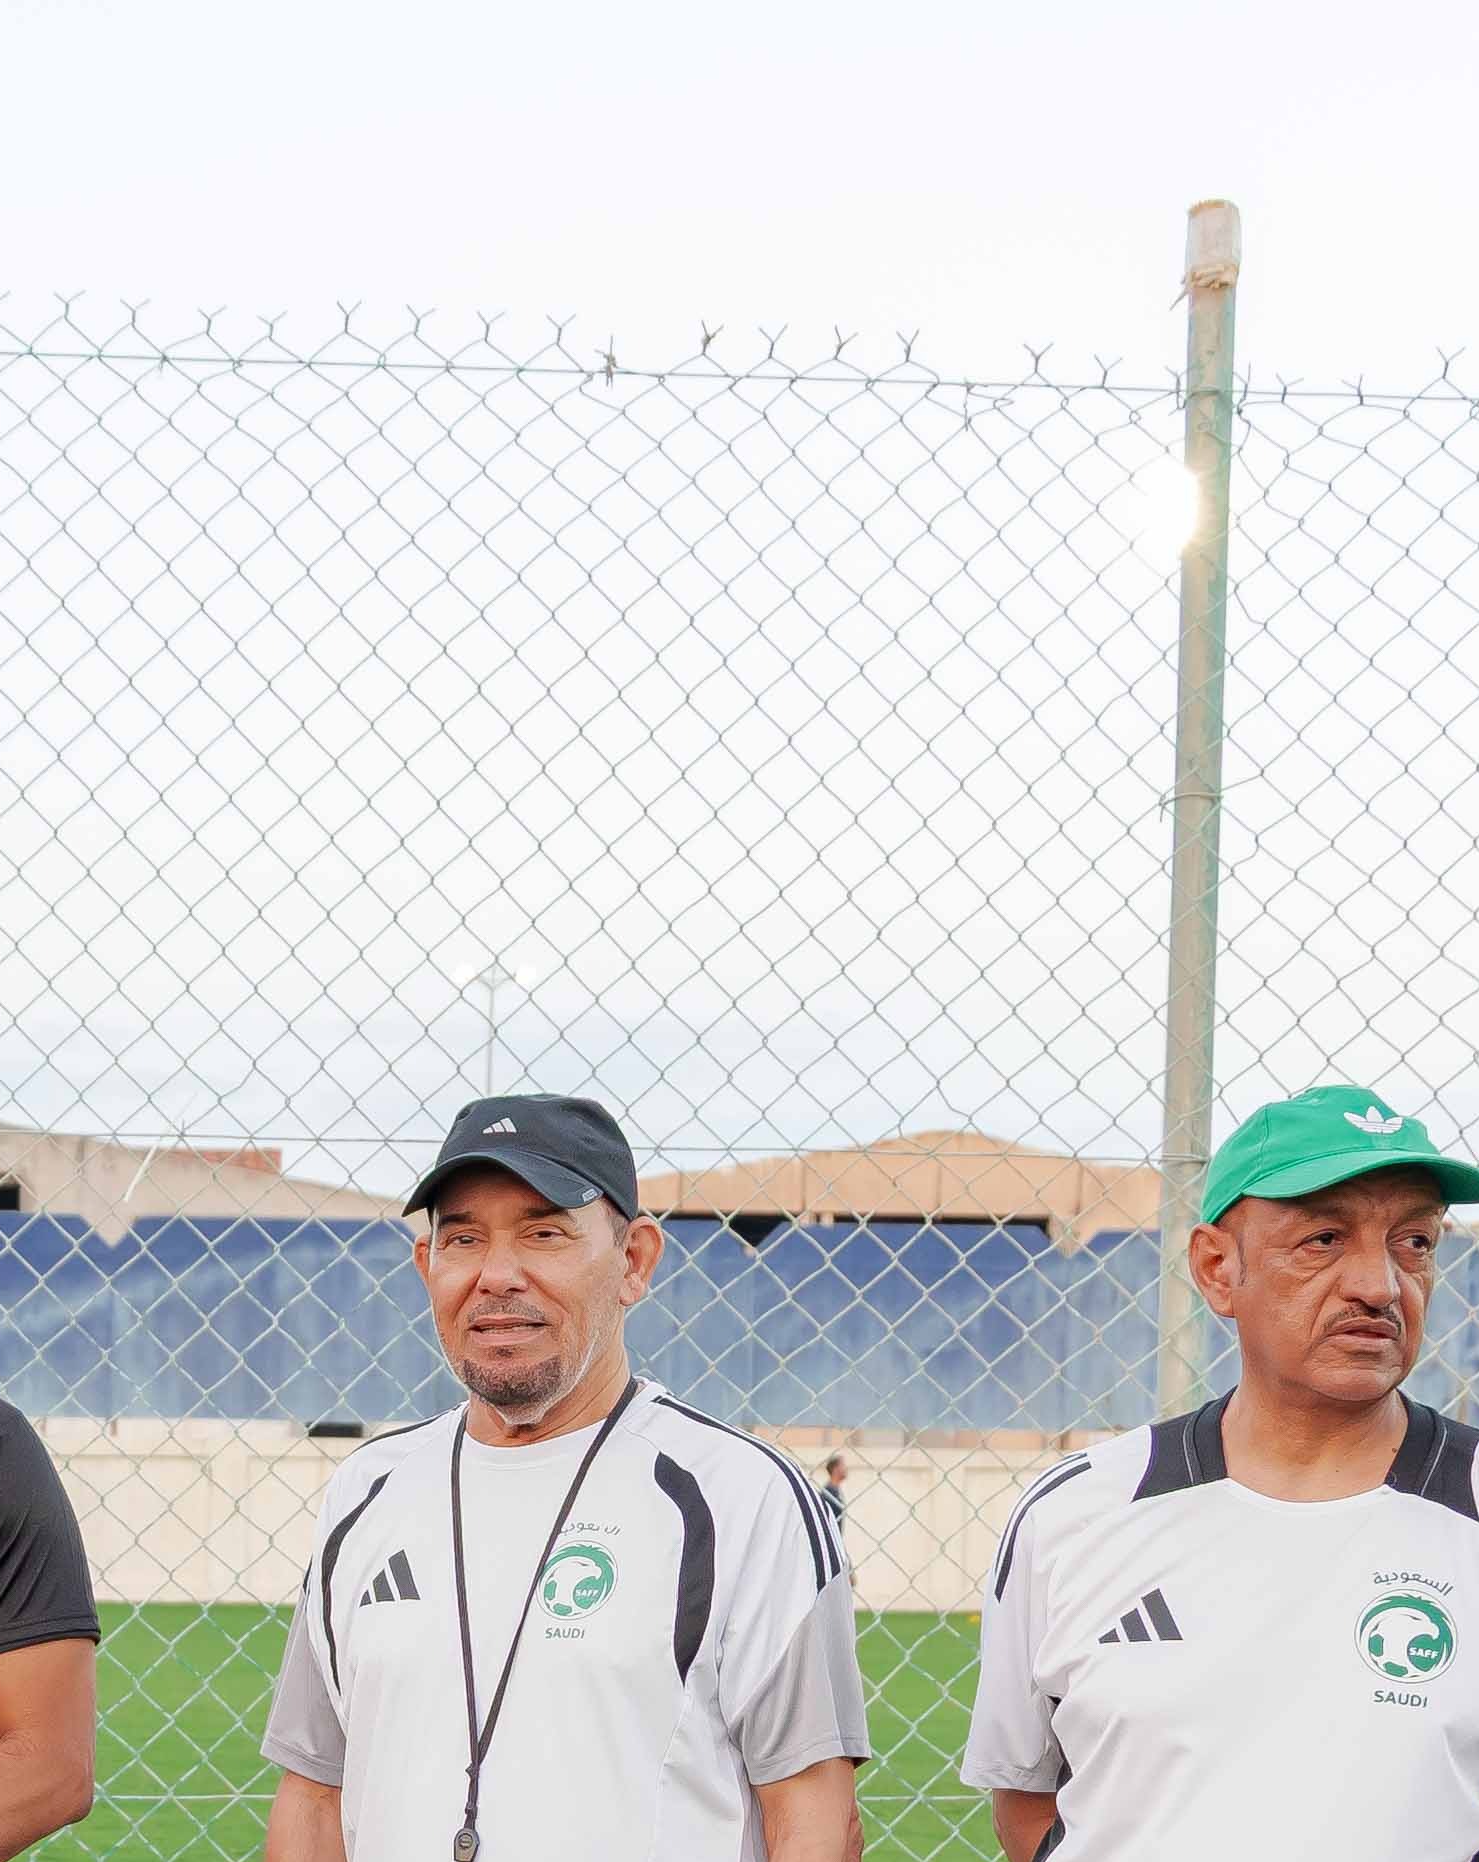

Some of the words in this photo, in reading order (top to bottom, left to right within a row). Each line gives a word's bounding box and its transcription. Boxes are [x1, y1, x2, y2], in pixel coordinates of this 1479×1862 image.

[1373, 1571, 1454, 1597] السعودية
[545, 1627, 585, 1639] SAUDI
[1409, 1648, 1439, 1659] SAFF
[1373, 1690, 1428, 1708] SAUDI
